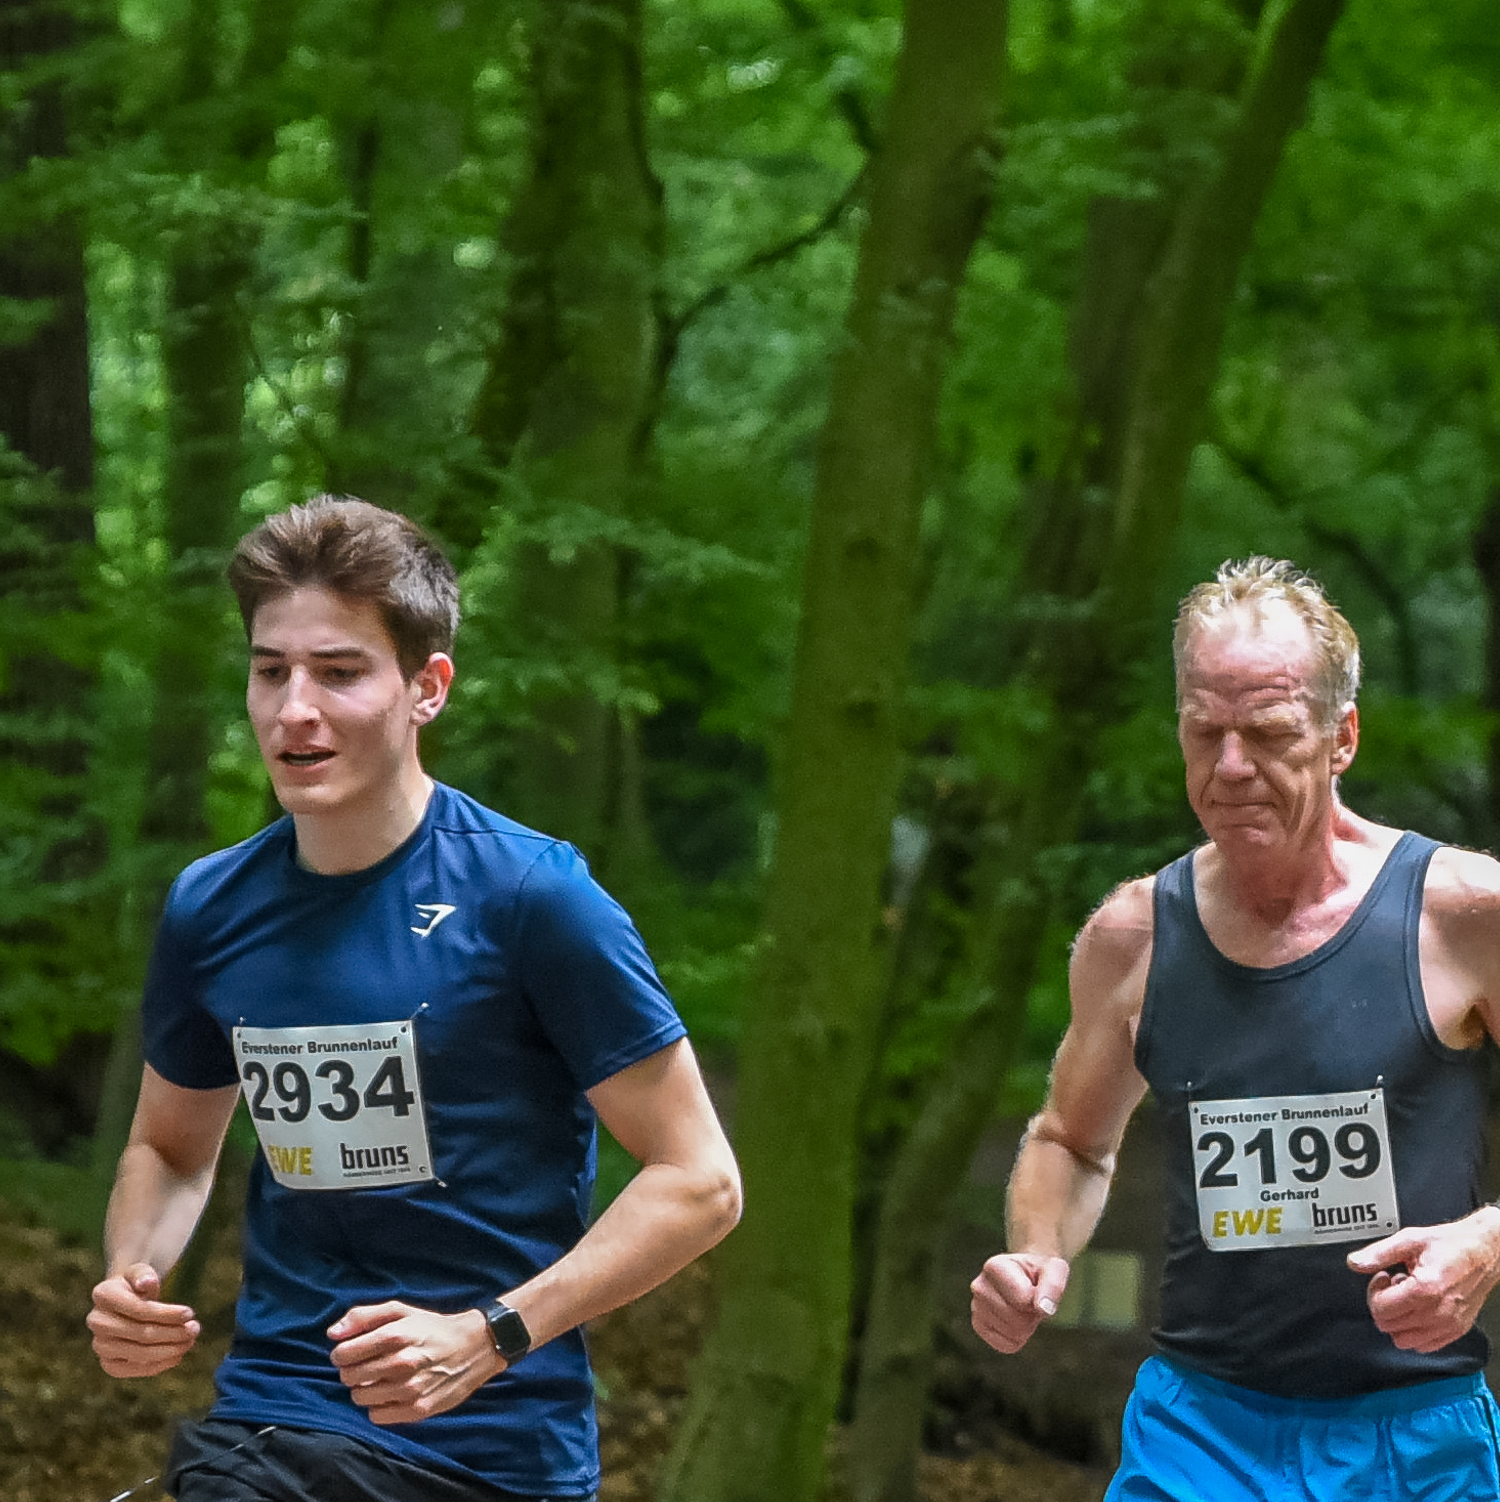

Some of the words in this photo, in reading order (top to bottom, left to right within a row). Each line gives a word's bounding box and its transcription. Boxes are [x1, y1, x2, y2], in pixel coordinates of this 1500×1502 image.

[241, 1041, 303, 1055] Everstener
[307, 1036, 398, 1053] Brunnenlauf
[243, 1056, 415, 1123] 2934
[1200, 1111, 1277, 1125] Everstener
[1281, 1103, 1369, 1120] Brunnenlauf
[340, 1143, 409, 1169] bruns
[1197, 1122, 1381, 1188] 2199
[1260, 1187, 1319, 1202] Gerhard
[1213, 1207, 1283, 1238] EWE
[1312, 1202, 1378, 1226] bruns
